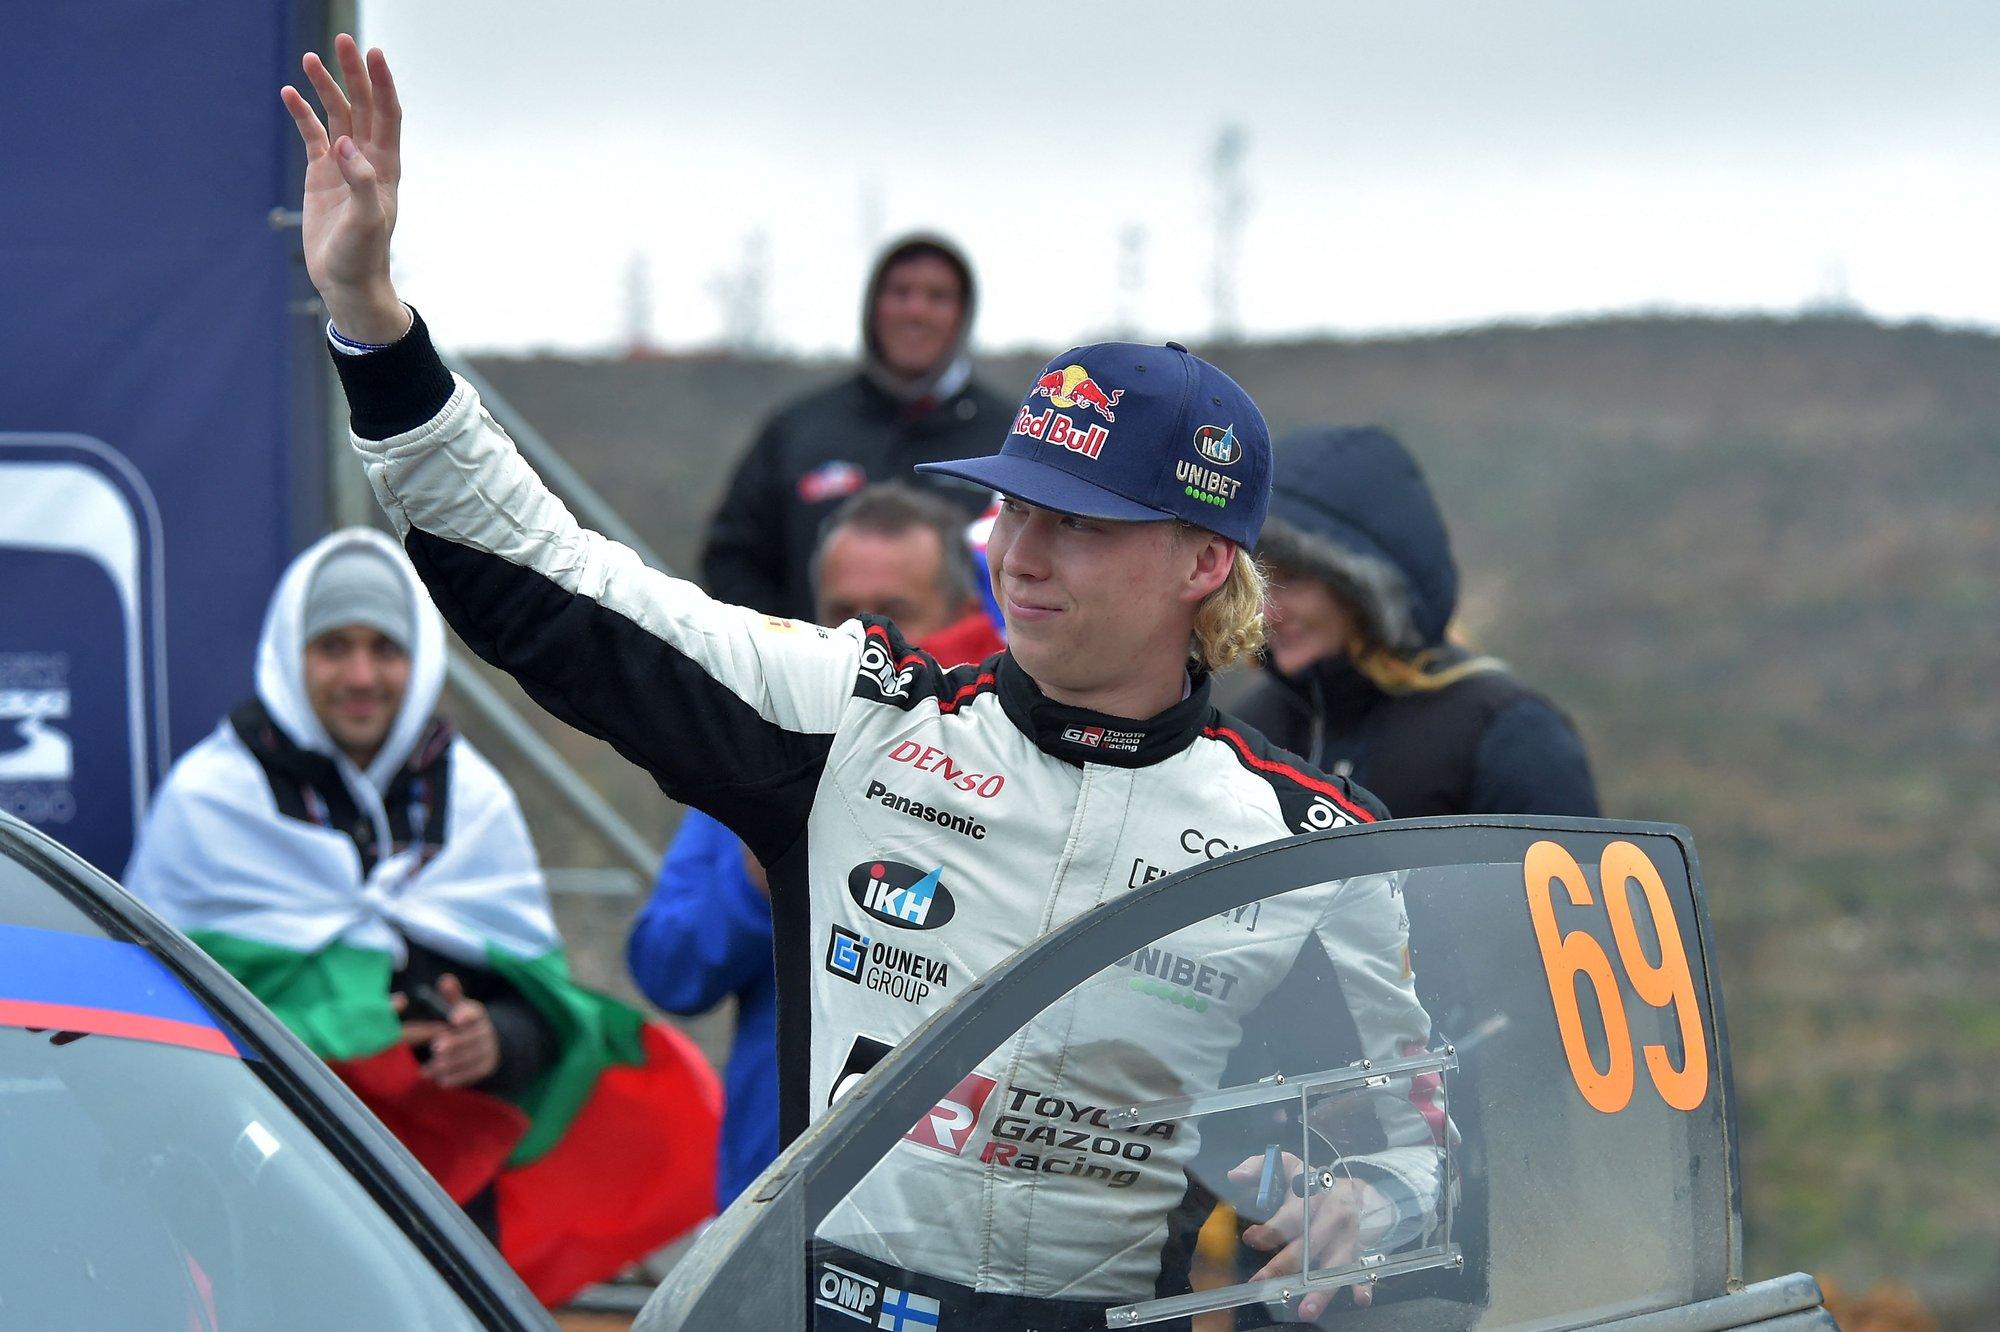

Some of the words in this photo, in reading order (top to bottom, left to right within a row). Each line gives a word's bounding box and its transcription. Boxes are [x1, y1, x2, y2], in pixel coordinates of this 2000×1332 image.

[1012, 405, 1054, 440] Red
[1046, 413, 1109, 460] Bull
[1175, 460, 1241, 500] UNIBET
[860, 647, 913, 694] OMP
[1064, 728, 1100, 746] GR
[1101, 741, 1138, 753] Racing
[1103, 735, 1141, 745] GAZOO
[1106, 729, 1146, 738] TOYOTA
[888, 740, 1006, 798] DENSO
[865, 780, 987, 840] Panasonic
[866, 967, 930, 1006] GROUP
[872, 942, 950, 988] OUNEVA
[1524, 841, 1709, 1113] 69
[1008, 1086, 1176, 1142] TOYOA
[992, 1115, 1153, 1162] GAZOO
[980, 1141, 1142, 1189] Racing
[820, 1272, 876, 1313] OMP
